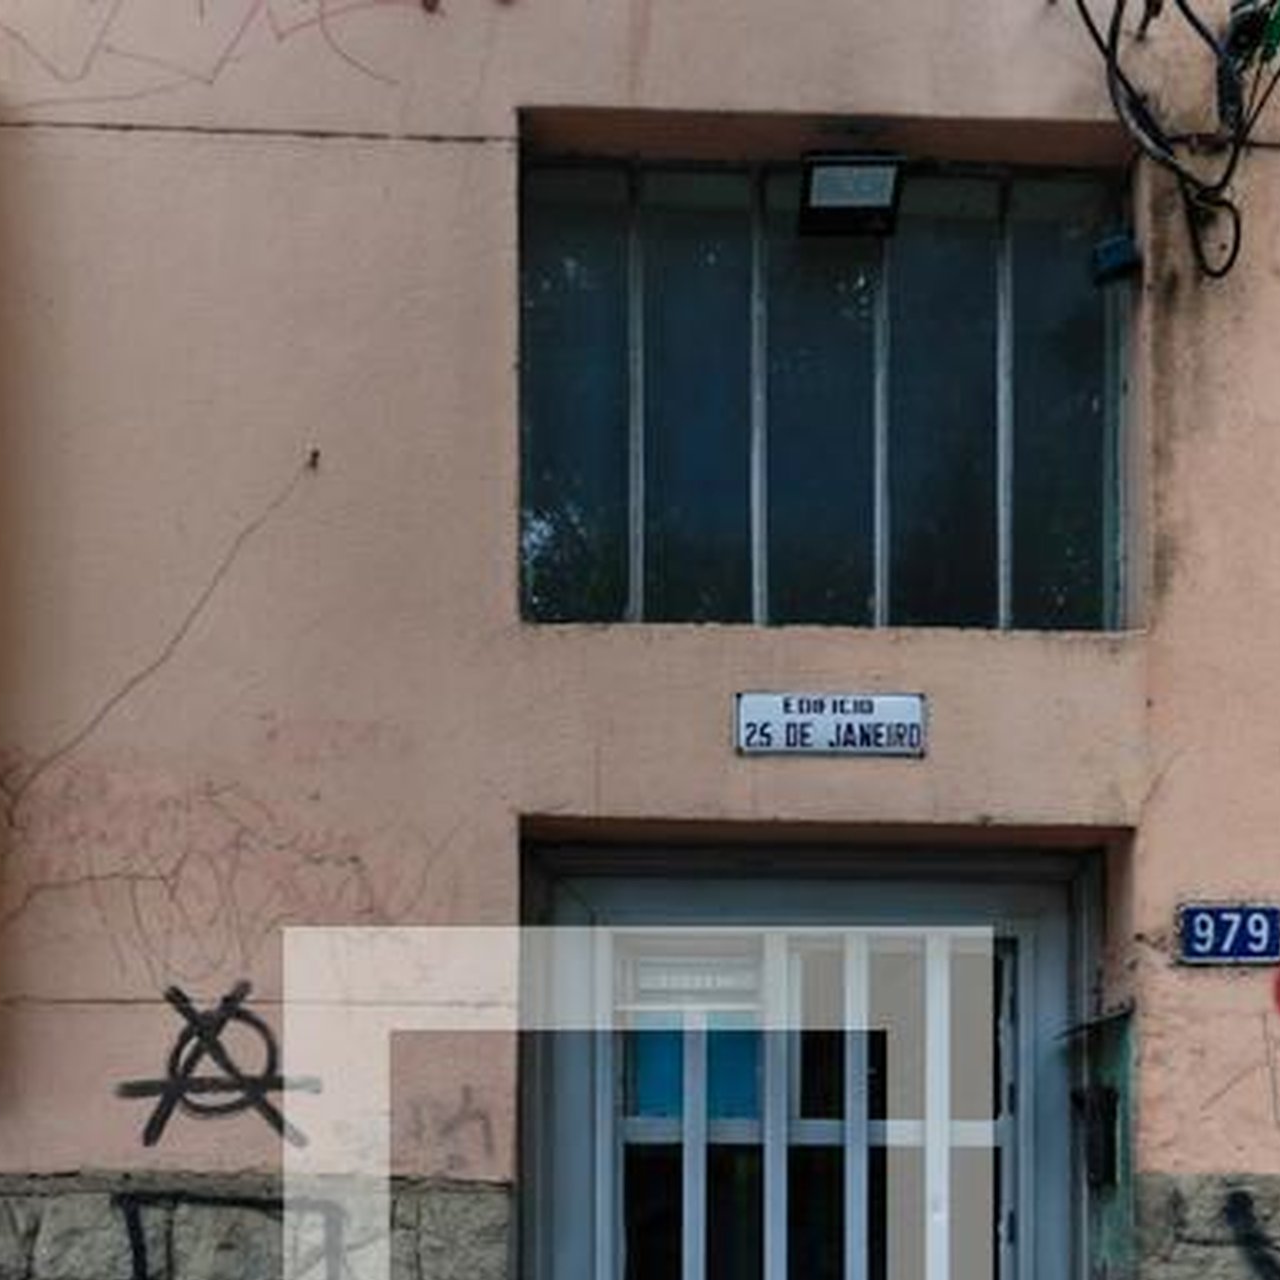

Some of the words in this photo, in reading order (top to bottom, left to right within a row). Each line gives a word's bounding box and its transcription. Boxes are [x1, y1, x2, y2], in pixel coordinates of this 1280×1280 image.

[782, 697, 875, 715] EDIFICIO
[745, 722, 772, 748] 25
[785, 722, 814, 748] DE
[827, 722, 922, 748] JANEIRO
[1192, 912, 1270, 953] 979
